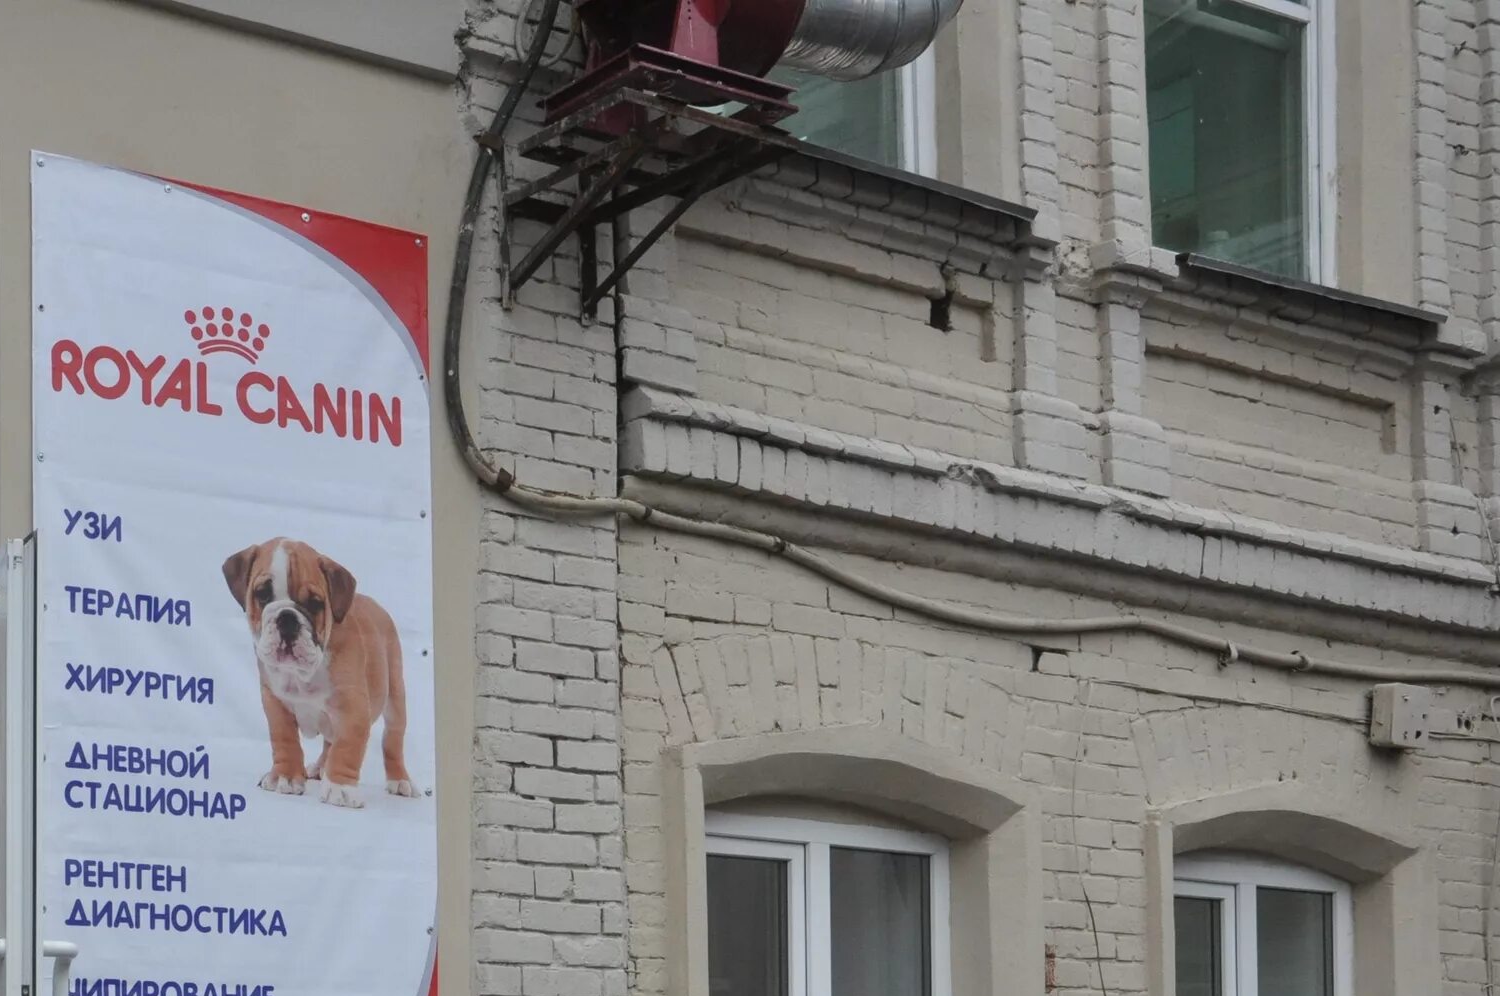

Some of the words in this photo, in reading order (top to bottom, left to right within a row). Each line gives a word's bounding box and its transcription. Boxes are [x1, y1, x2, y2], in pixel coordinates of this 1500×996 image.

[52, 339, 222, 416] ROYAL
[235, 371, 402, 447] CANIN
[63, 508, 122, 543] УЗИ
[64, 585, 191, 627] ТЕРАПИЯ
[64, 662, 214, 705] ХИРУРГИЯ
[64, 741, 210, 780] ДНЕВНОЙ
[64, 779, 247, 820] СТАЦИОНАР
[64, 858, 187, 893] РЕНТГЕН
[64, 898, 288, 937] ДИАГНОСТИКА
